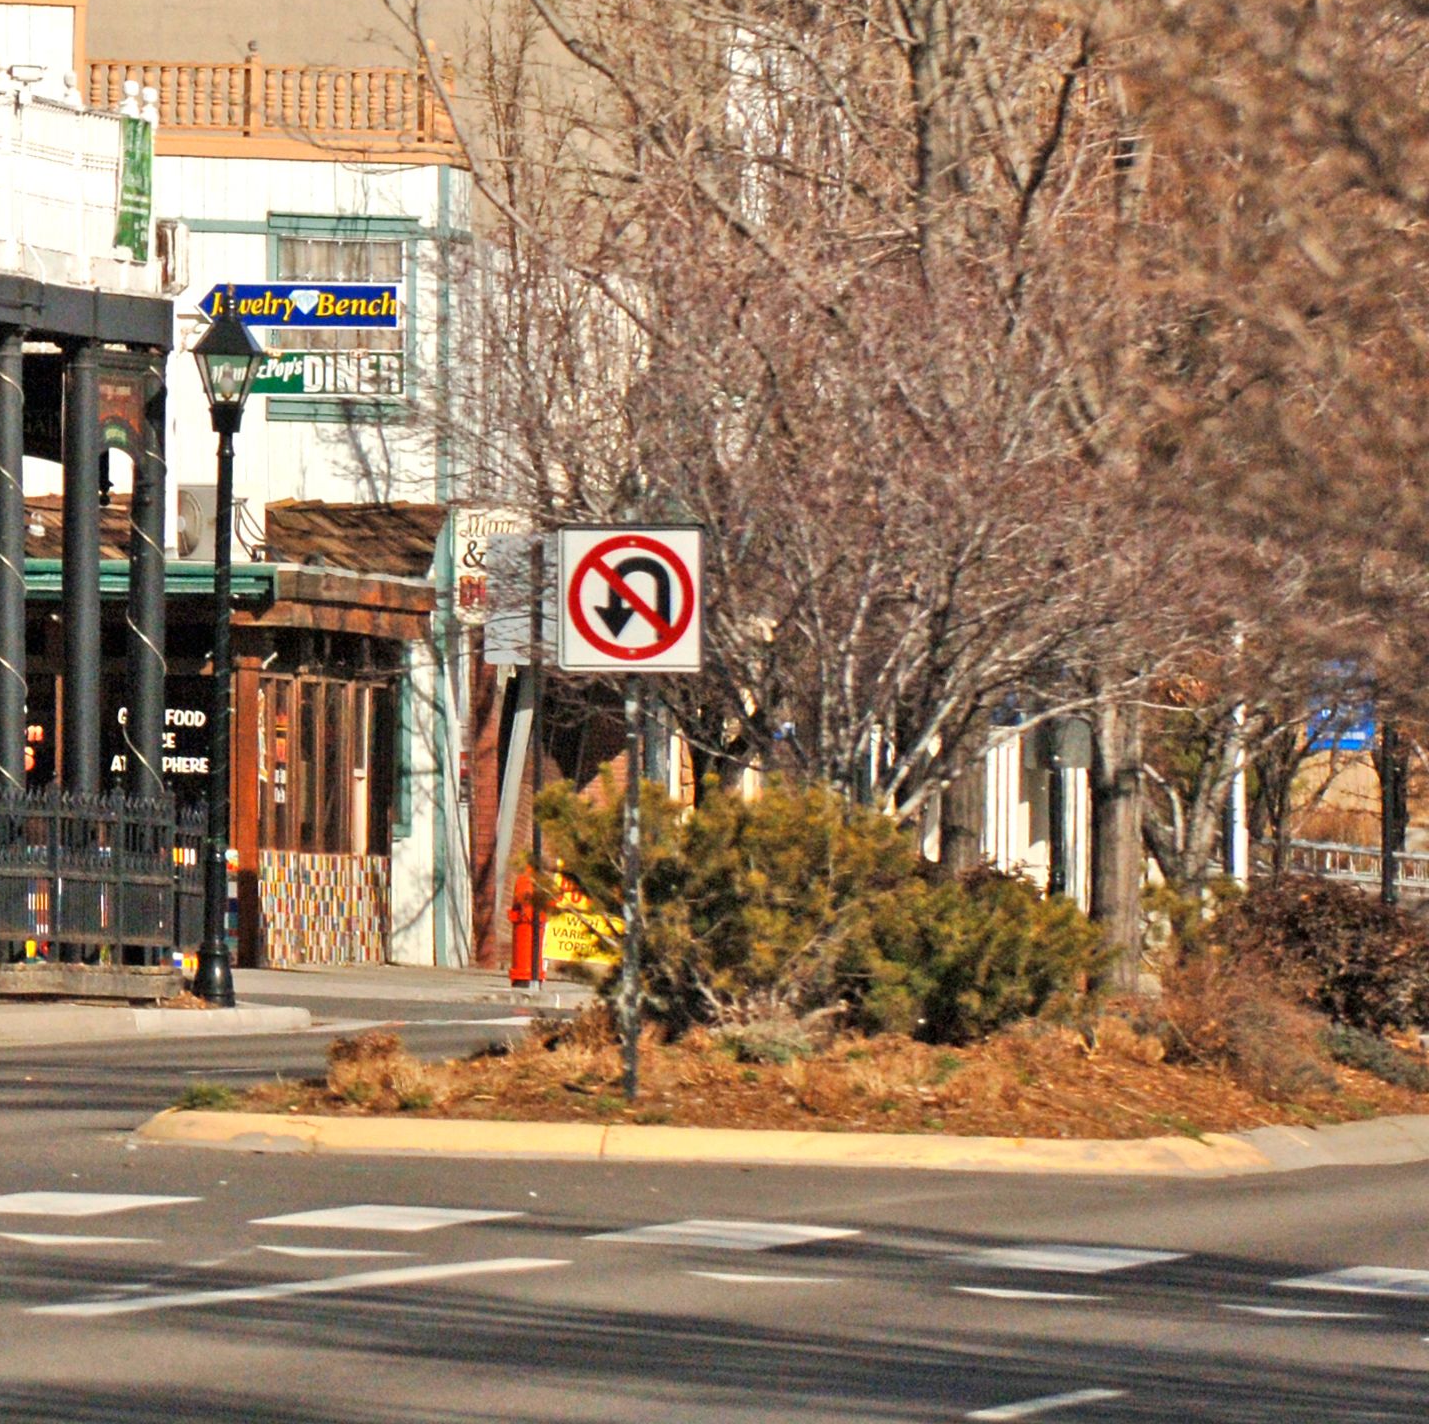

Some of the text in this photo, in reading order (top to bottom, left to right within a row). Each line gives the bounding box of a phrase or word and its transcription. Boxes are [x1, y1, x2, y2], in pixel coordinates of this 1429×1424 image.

[210, 290, 397, 322] Jwelry Bench
[303, 354, 400, 393] DINER
[462, 540, 487, 570] &
[164, 708, 207, 728] FOOD
